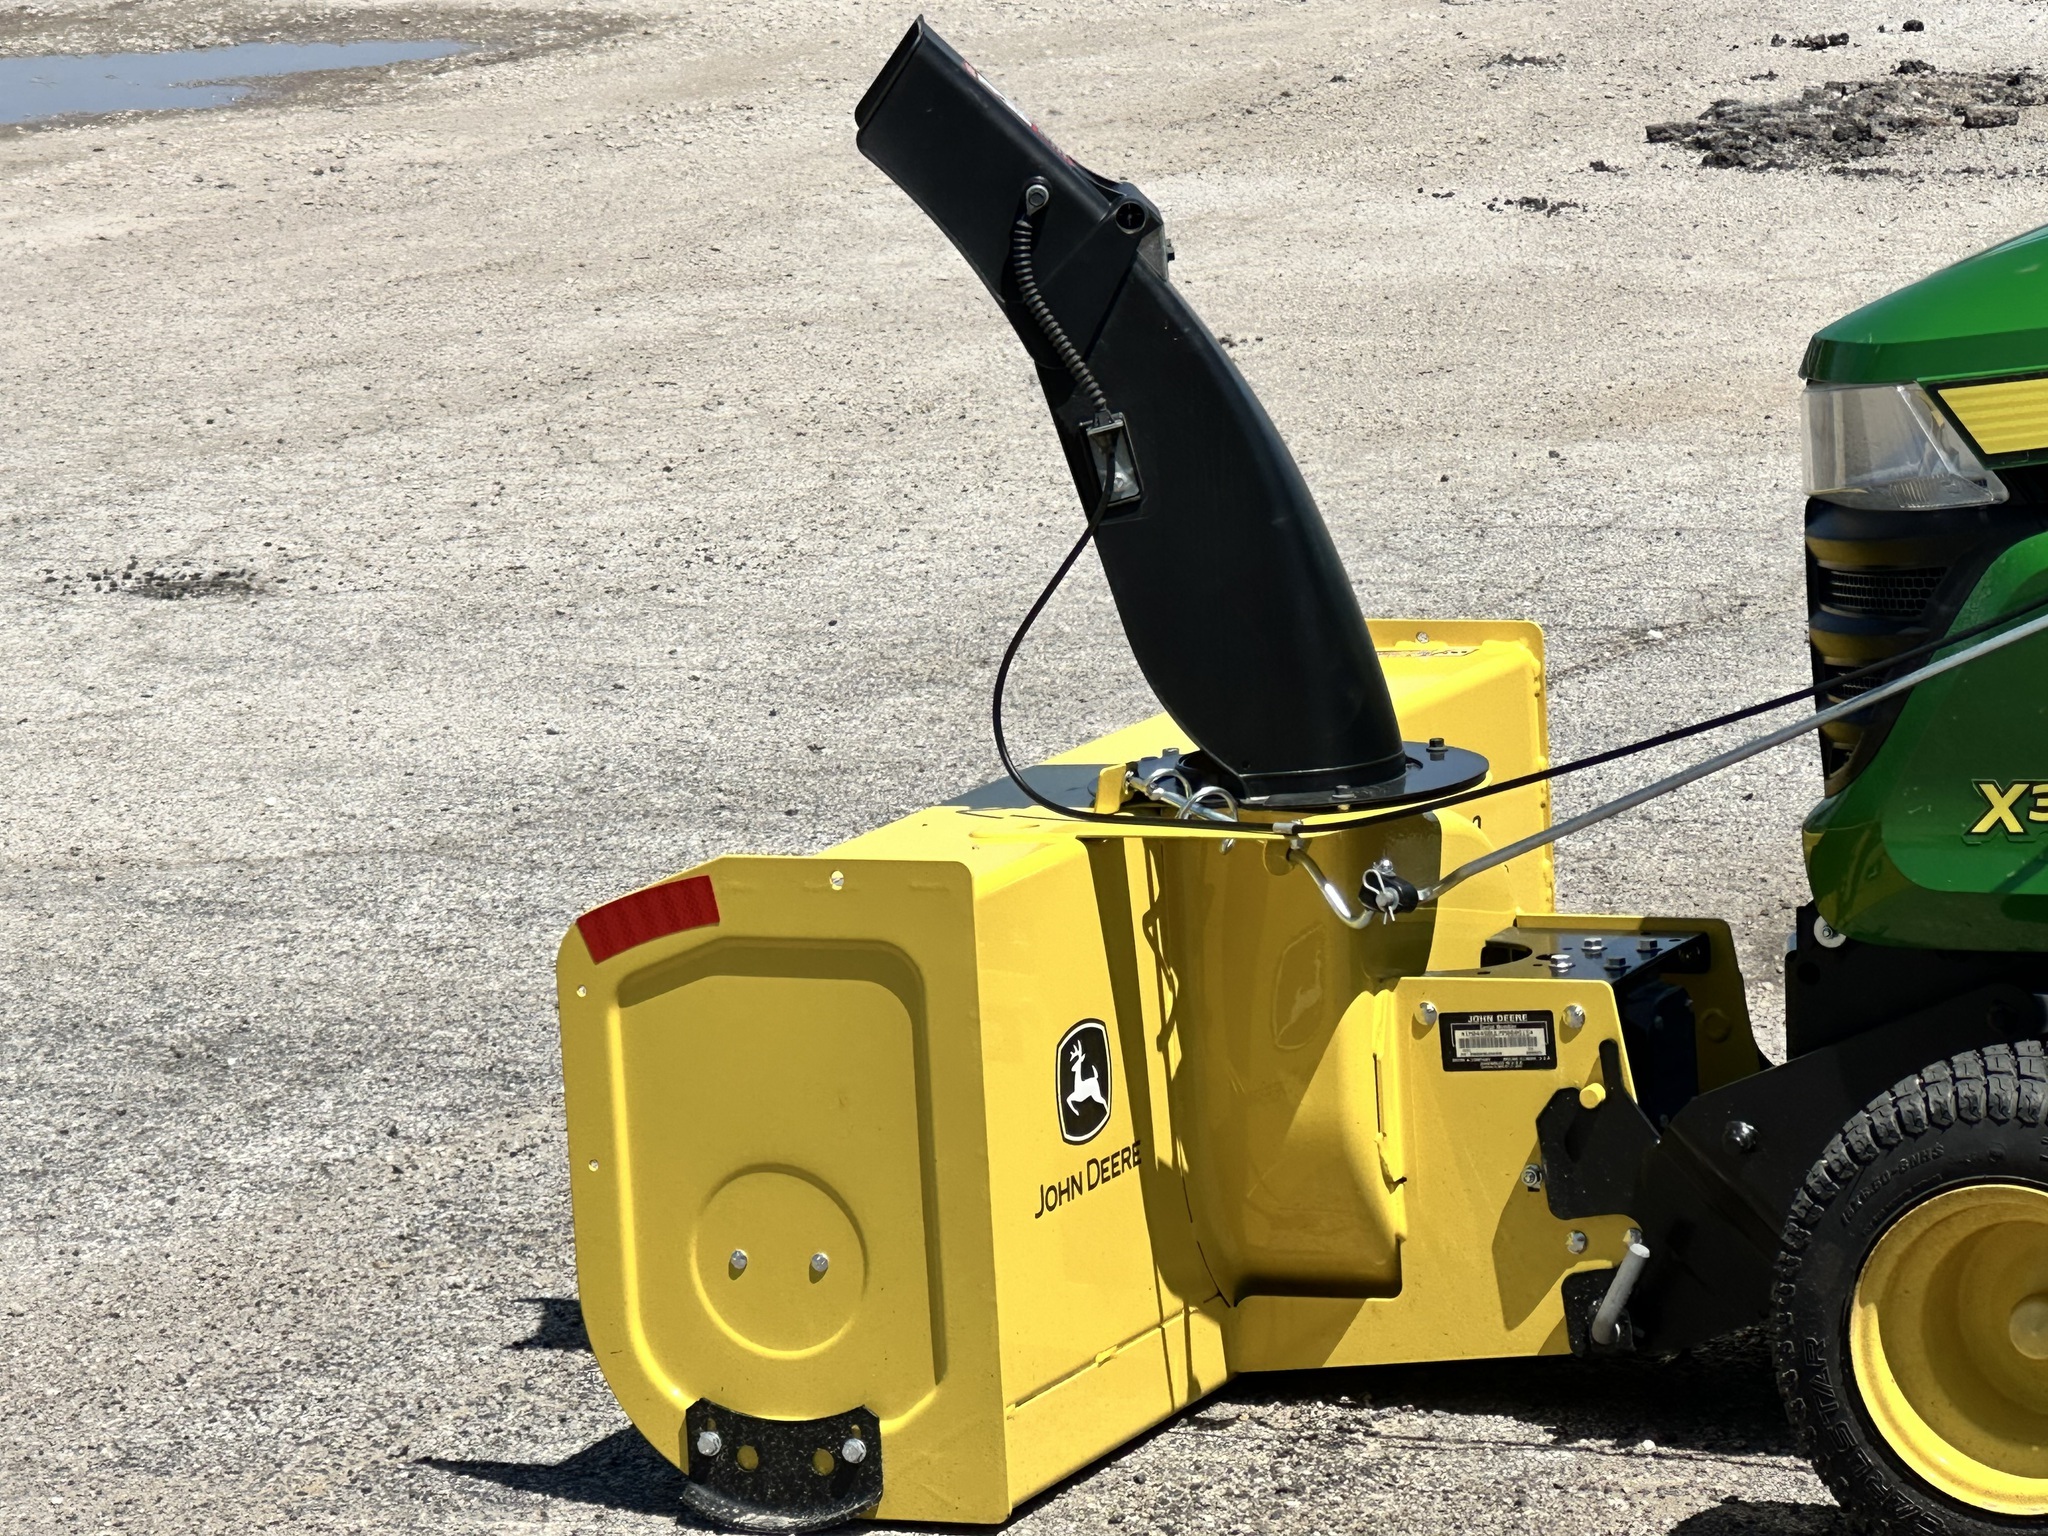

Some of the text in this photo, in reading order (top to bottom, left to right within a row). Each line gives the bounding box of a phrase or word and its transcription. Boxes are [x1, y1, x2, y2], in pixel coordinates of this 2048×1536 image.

[1467, 1013, 1528, 1023] JOHN DEERE
[1034, 1140, 1142, 1219] JOHN DEERE
